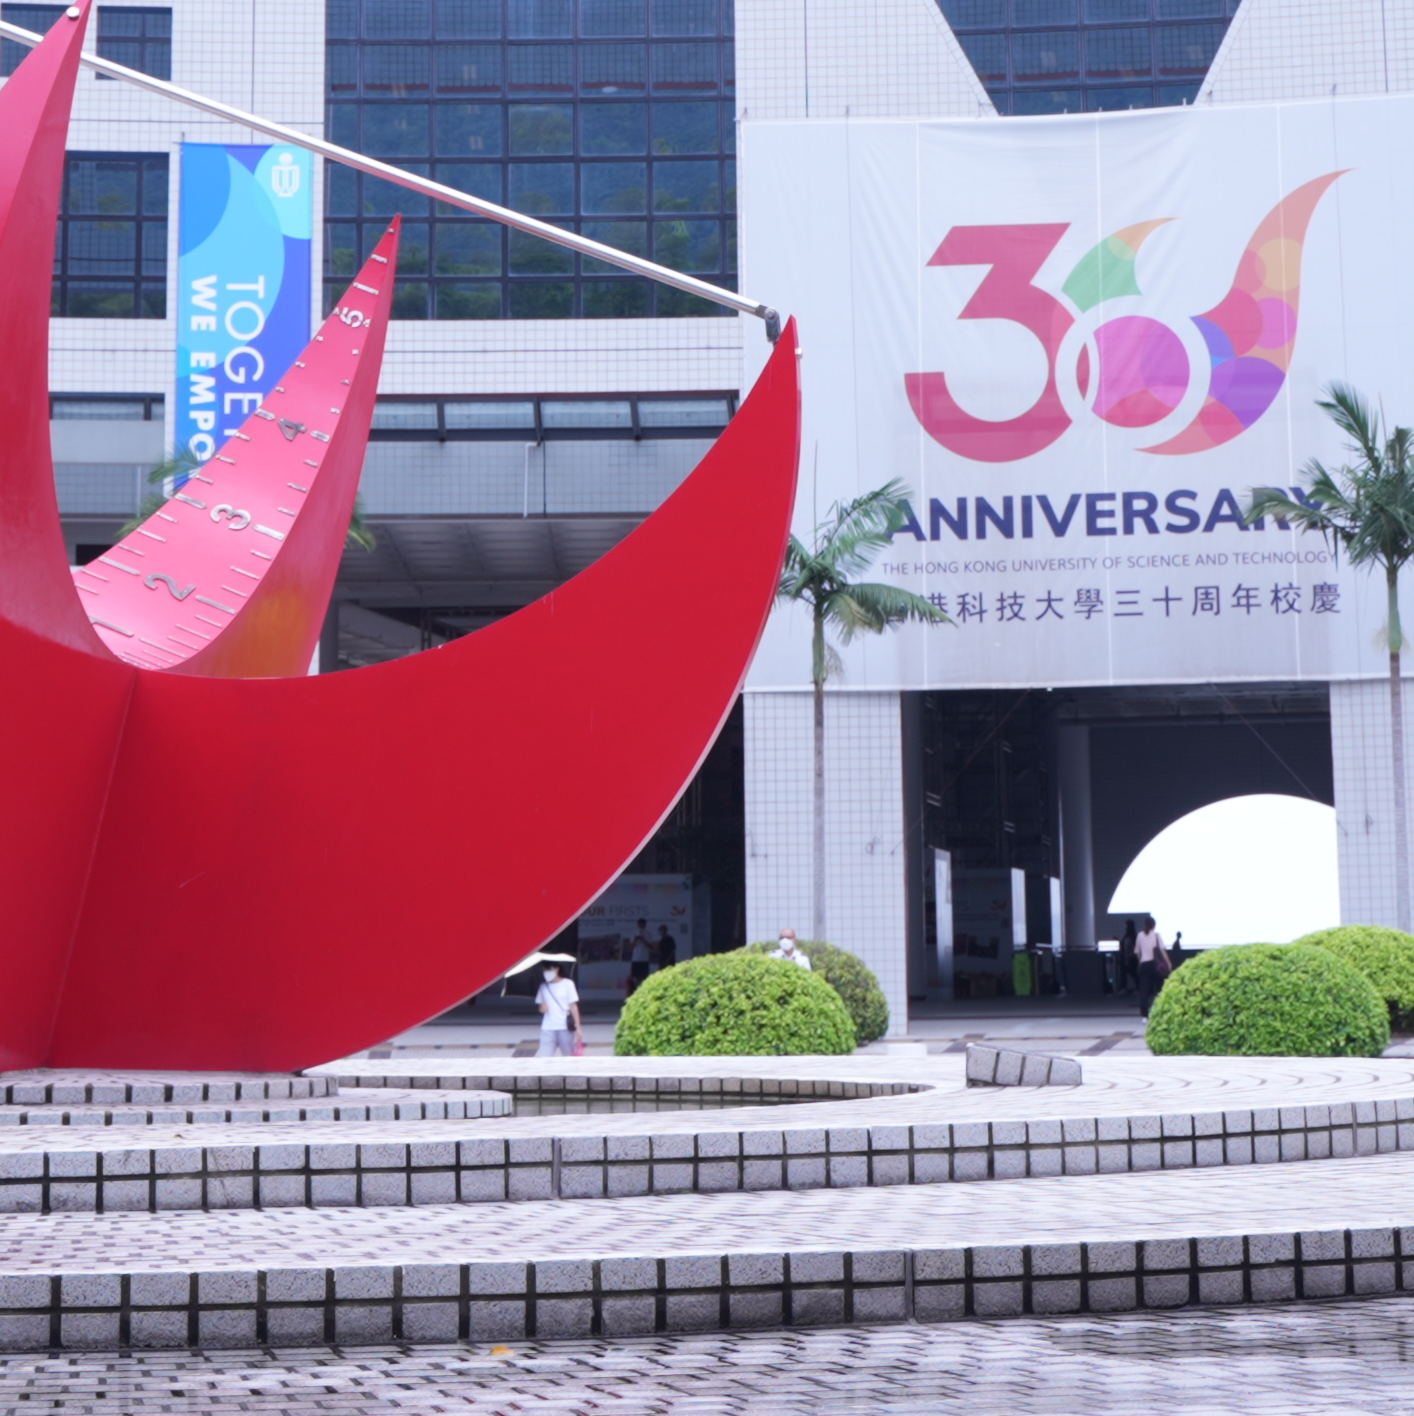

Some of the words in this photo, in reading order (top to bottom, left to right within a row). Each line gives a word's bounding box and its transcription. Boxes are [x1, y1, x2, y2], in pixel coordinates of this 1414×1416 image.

[189, 275, 218, 332] WE
[187, 351, 216, 478] EMPO
[277, 418, 308, 442] 4
[209, 503, 251, 531] 3
[881, 563, 909, 575] THE
[914, 561, 959, 574] HONG
[964, 559, 1007, 573] KONG
[1012, 557, 1098, 572] UNIVERSITY
[1102, 556, 1122, 569] OF
[1127, 553, 1190, 569] SCIENCE
[1195, 552, 1228, 566] AND
[1233, 550, 1338, 564] TECHNOLOGY
[143, 572, 197, 601] 2
